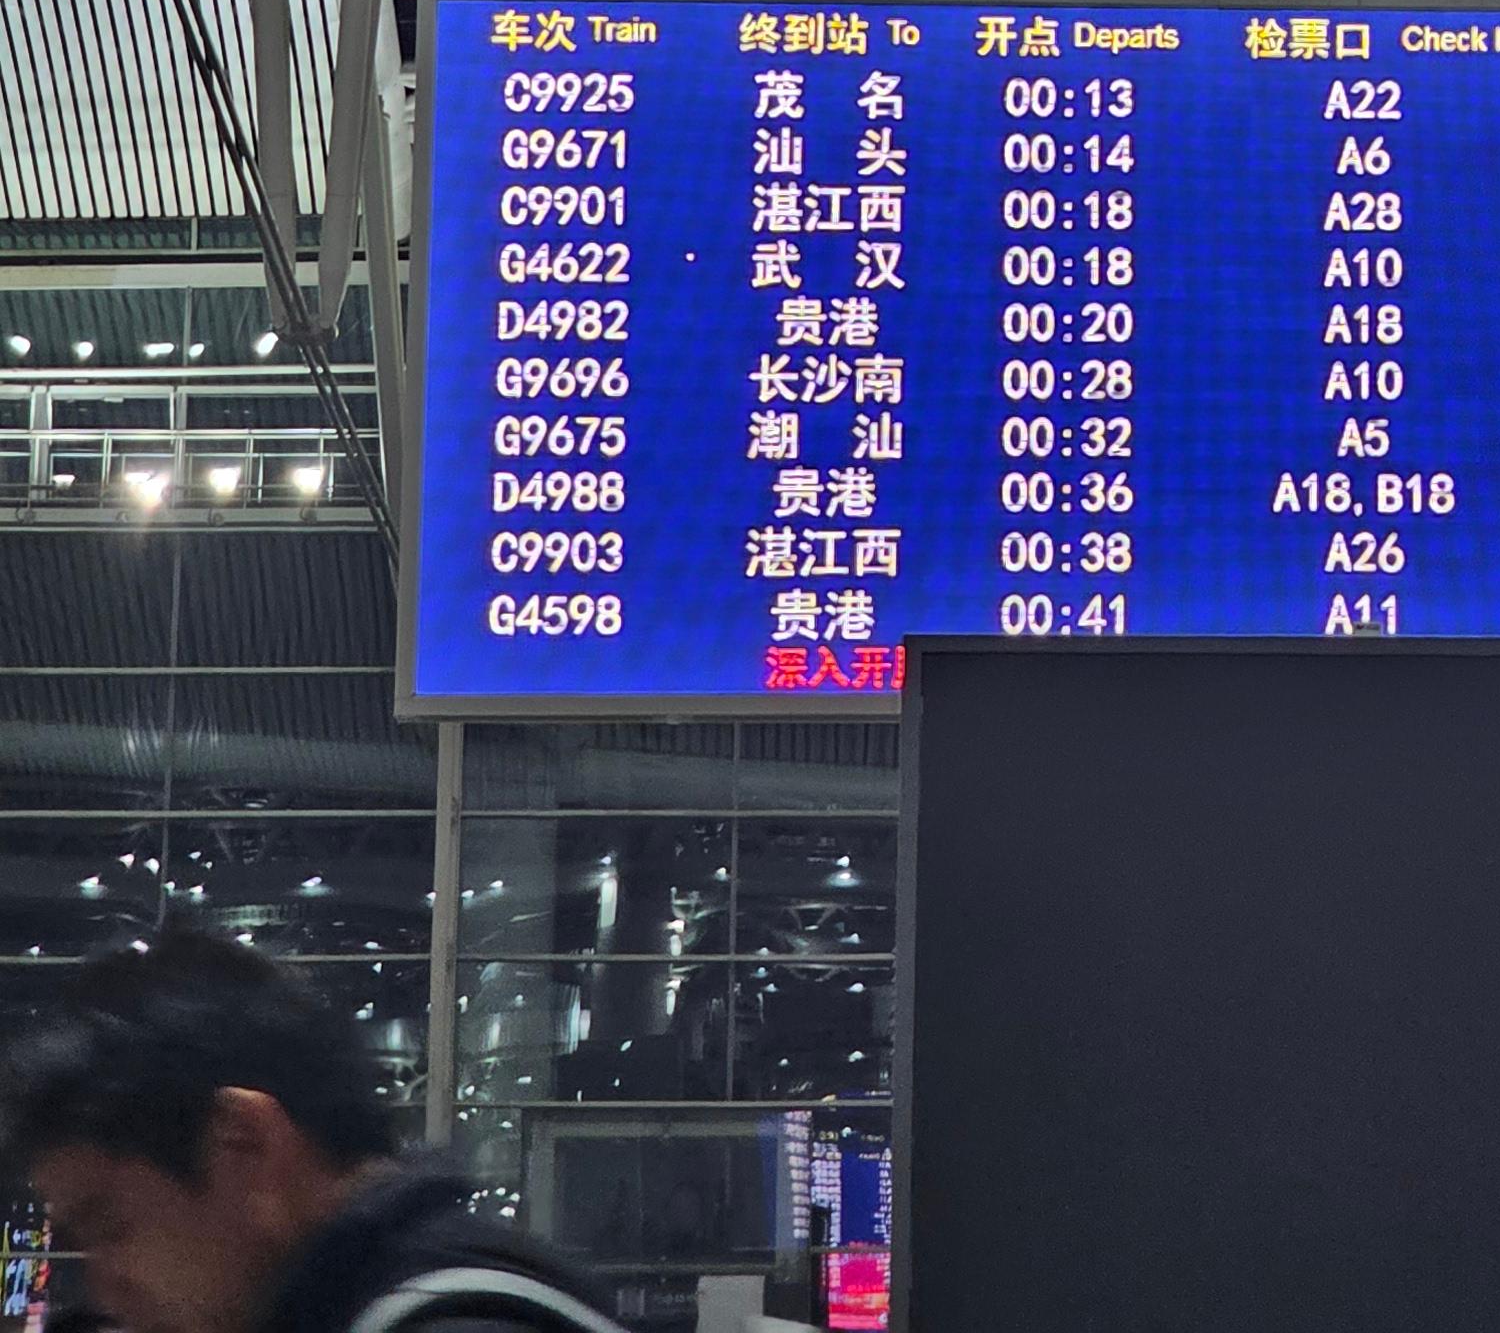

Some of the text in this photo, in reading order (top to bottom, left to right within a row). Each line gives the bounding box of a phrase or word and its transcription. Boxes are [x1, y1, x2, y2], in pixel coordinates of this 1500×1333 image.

[490, 9, 577, 52] 车次
[587, 15, 657, 43] Train
[738, 12, 869, 55] 终到站
[886, 19, 920, 46] To
[975, 15, 1060, 57] 开点
[1073, 21, 1180, 55] Departs
[1244, 17, 1370, 60] 检票口
[1401, 25, 1489, 53] Check
[503, 72, 634, 113] C9925
[1004, 77, 1133, 118] 00:13
[1323, 80, 1402, 120] A22
[502, 128, 626, 170] G9671
[1004, 133, 1134, 173] 00:14
[1336, 136, 1391, 176] A6
[500, 185, 624, 226] C9901
[752, 181, 906, 233] 湛江西
[1004, 190, 1133, 230] 00:18
[1323, 191, 1402, 231] A28
[499, 242, 630, 283] G4622
[1003, 246, 1133, 286] 00:18
[1323, 247, 1403, 287] A10
[497, 299, 629, 341] D4982
[775, 295, 879, 346] 贵港
[1003, 302, 1133, 343] 00:20
[1323, 304, 1403, 344] A18
[496, 357, 629, 398] G9696
[748, 353, 904, 404] 长沙南
[1002, 359, 1133, 400] 00:28
[1324, 360, 1403, 400] A10
[494, 415, 626, 457] G9675
[1002, 416, 1132, 457] 00:32
[1337, 417, 1390, 457] A5
[493, 471, 625, 512] D4988
[772, 467, 877, 518] 贵港
[1001, 472, 1134, 513] 00:36
[491, 531, 623, 573] C9903
[745, 525, 902, 577] 湛江西
[1001, 531, 1132, 573] 00:38
[1324, 531, 1405, 574] A26
[488, 594, 622, 636] G4598
[770, 588, 875, 642] 贵港
[1000, 594, 1125, 635] 00:41
[1324, 594, 1397, 632] A11
[765, 645, 905, 690] 深入开
